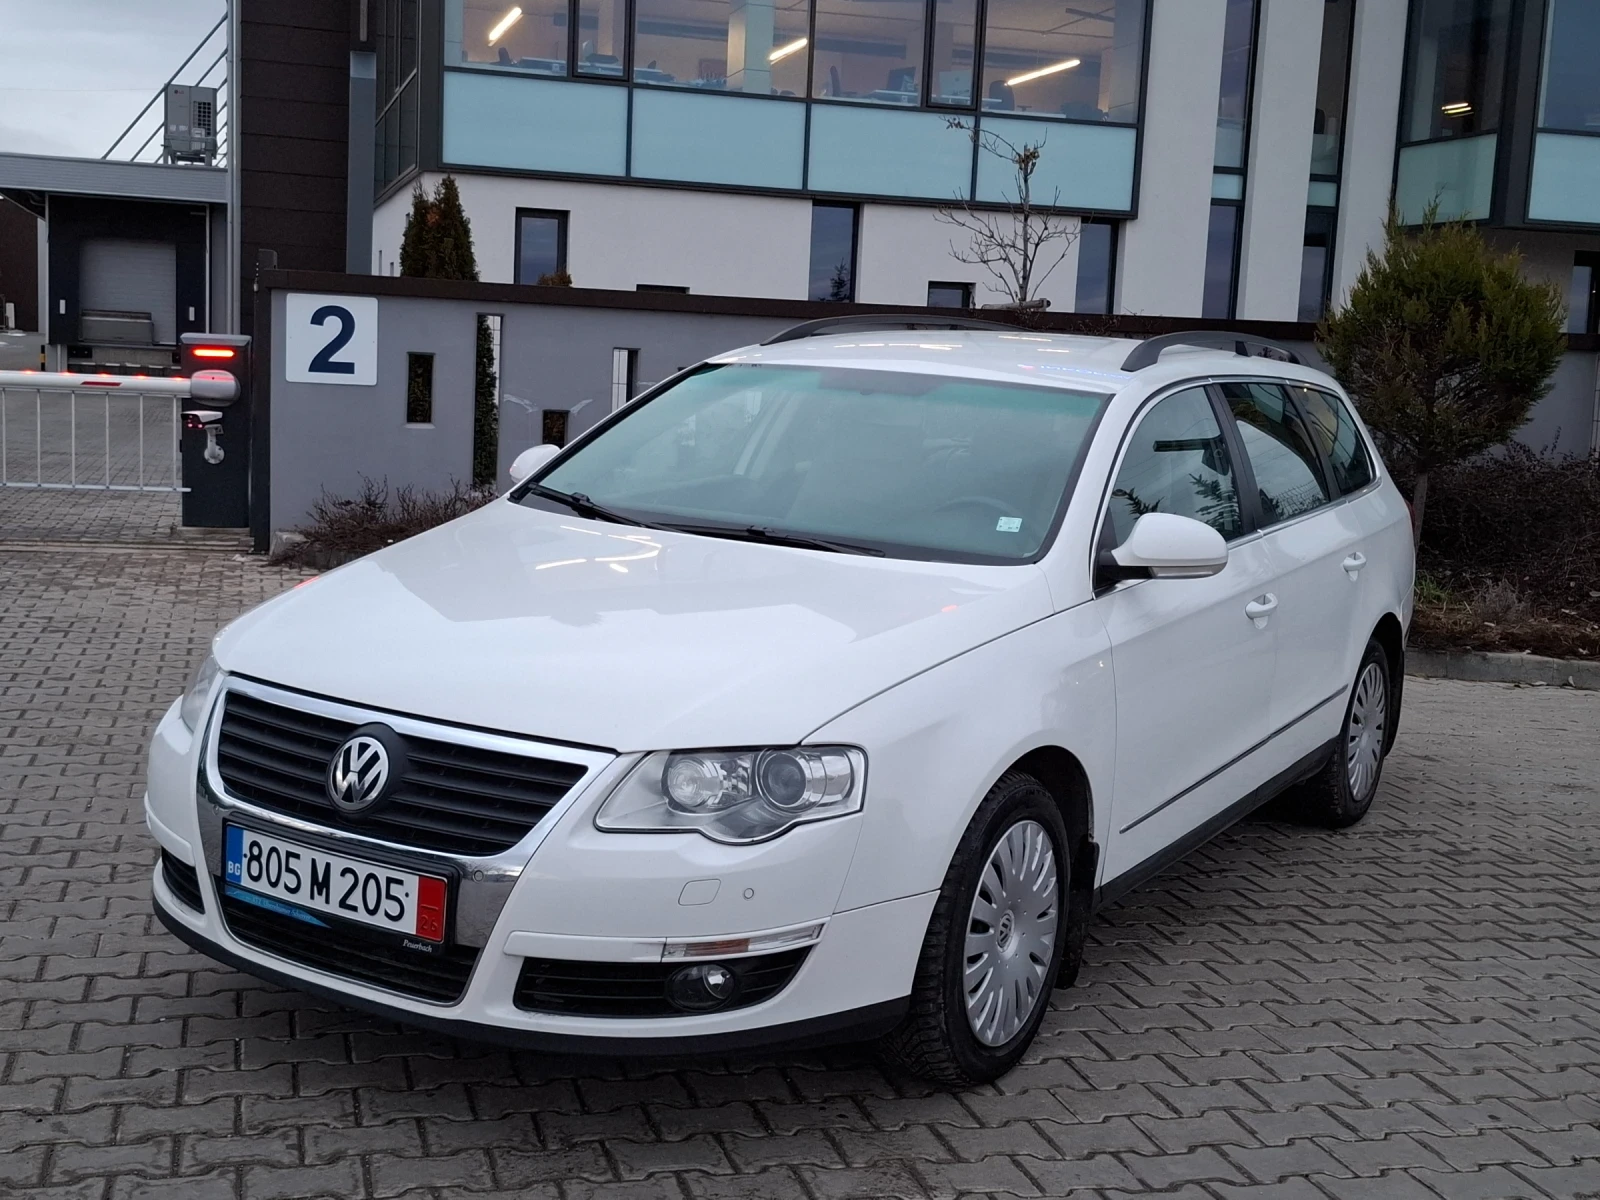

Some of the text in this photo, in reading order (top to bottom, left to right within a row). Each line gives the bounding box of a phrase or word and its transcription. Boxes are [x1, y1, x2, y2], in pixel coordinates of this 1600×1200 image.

[308, 305, 355, 374] 2
[331, 737, 389, 810] VW
[228, 861, 241, 875] BG
[247, 840, 302, 894] 805
[310, 857, 331, 905] M
[338, 867, 405, 922] 205
